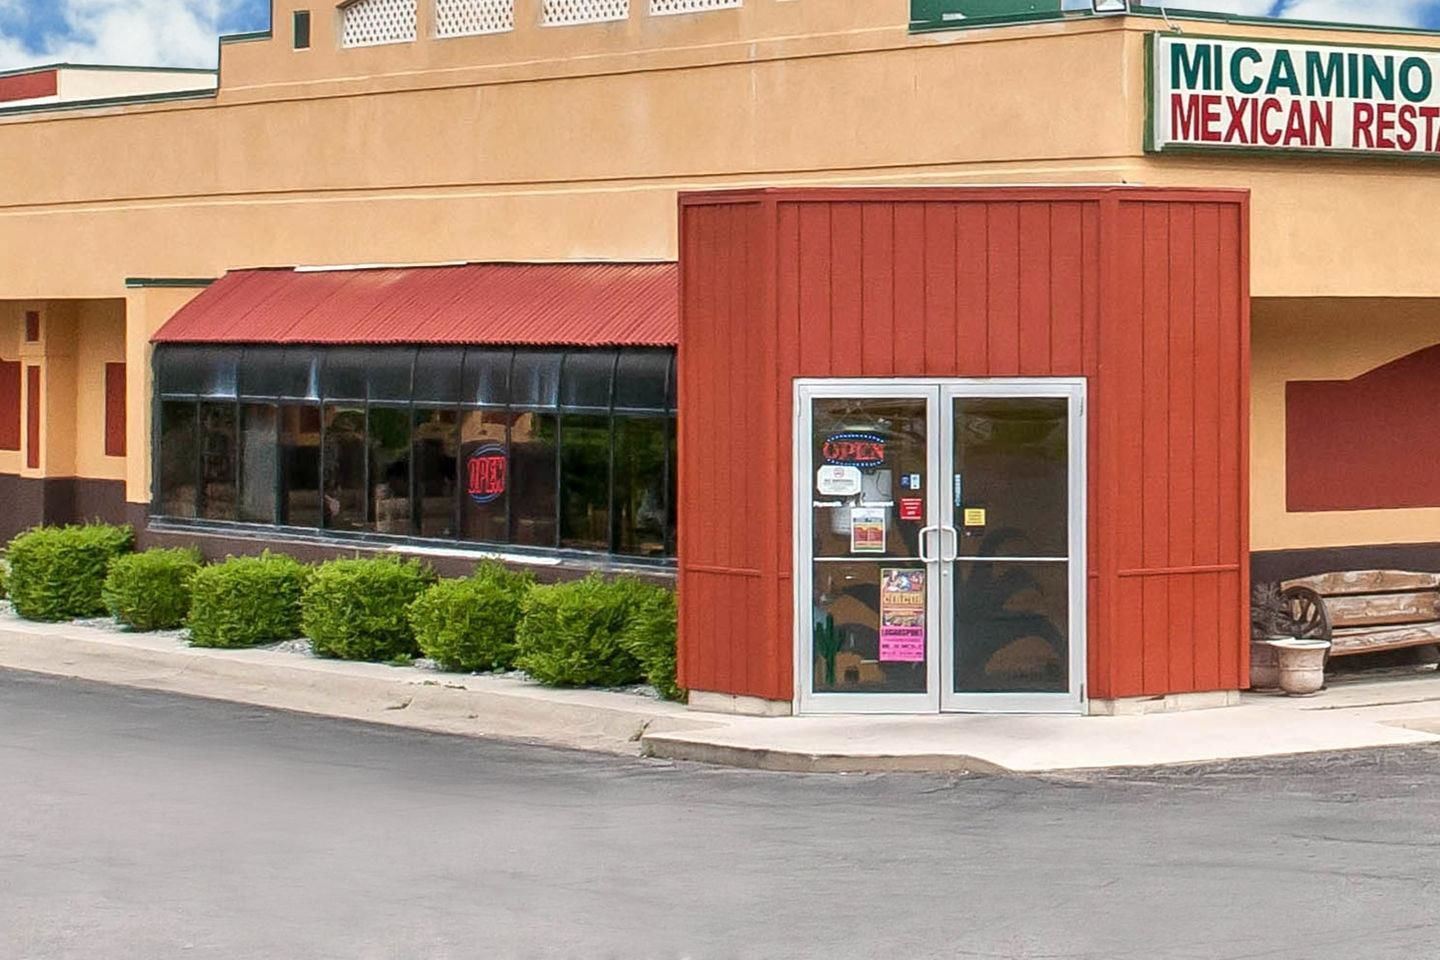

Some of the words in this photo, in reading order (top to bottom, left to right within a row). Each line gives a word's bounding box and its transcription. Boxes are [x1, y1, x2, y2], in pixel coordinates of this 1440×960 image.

[1171, 94, 1333, 147] MEXICAN
[1352, 102, 1440, 152] REST
[822, 441, 885, 460] OPEN
[467, 456, 506, 494] OPEN
